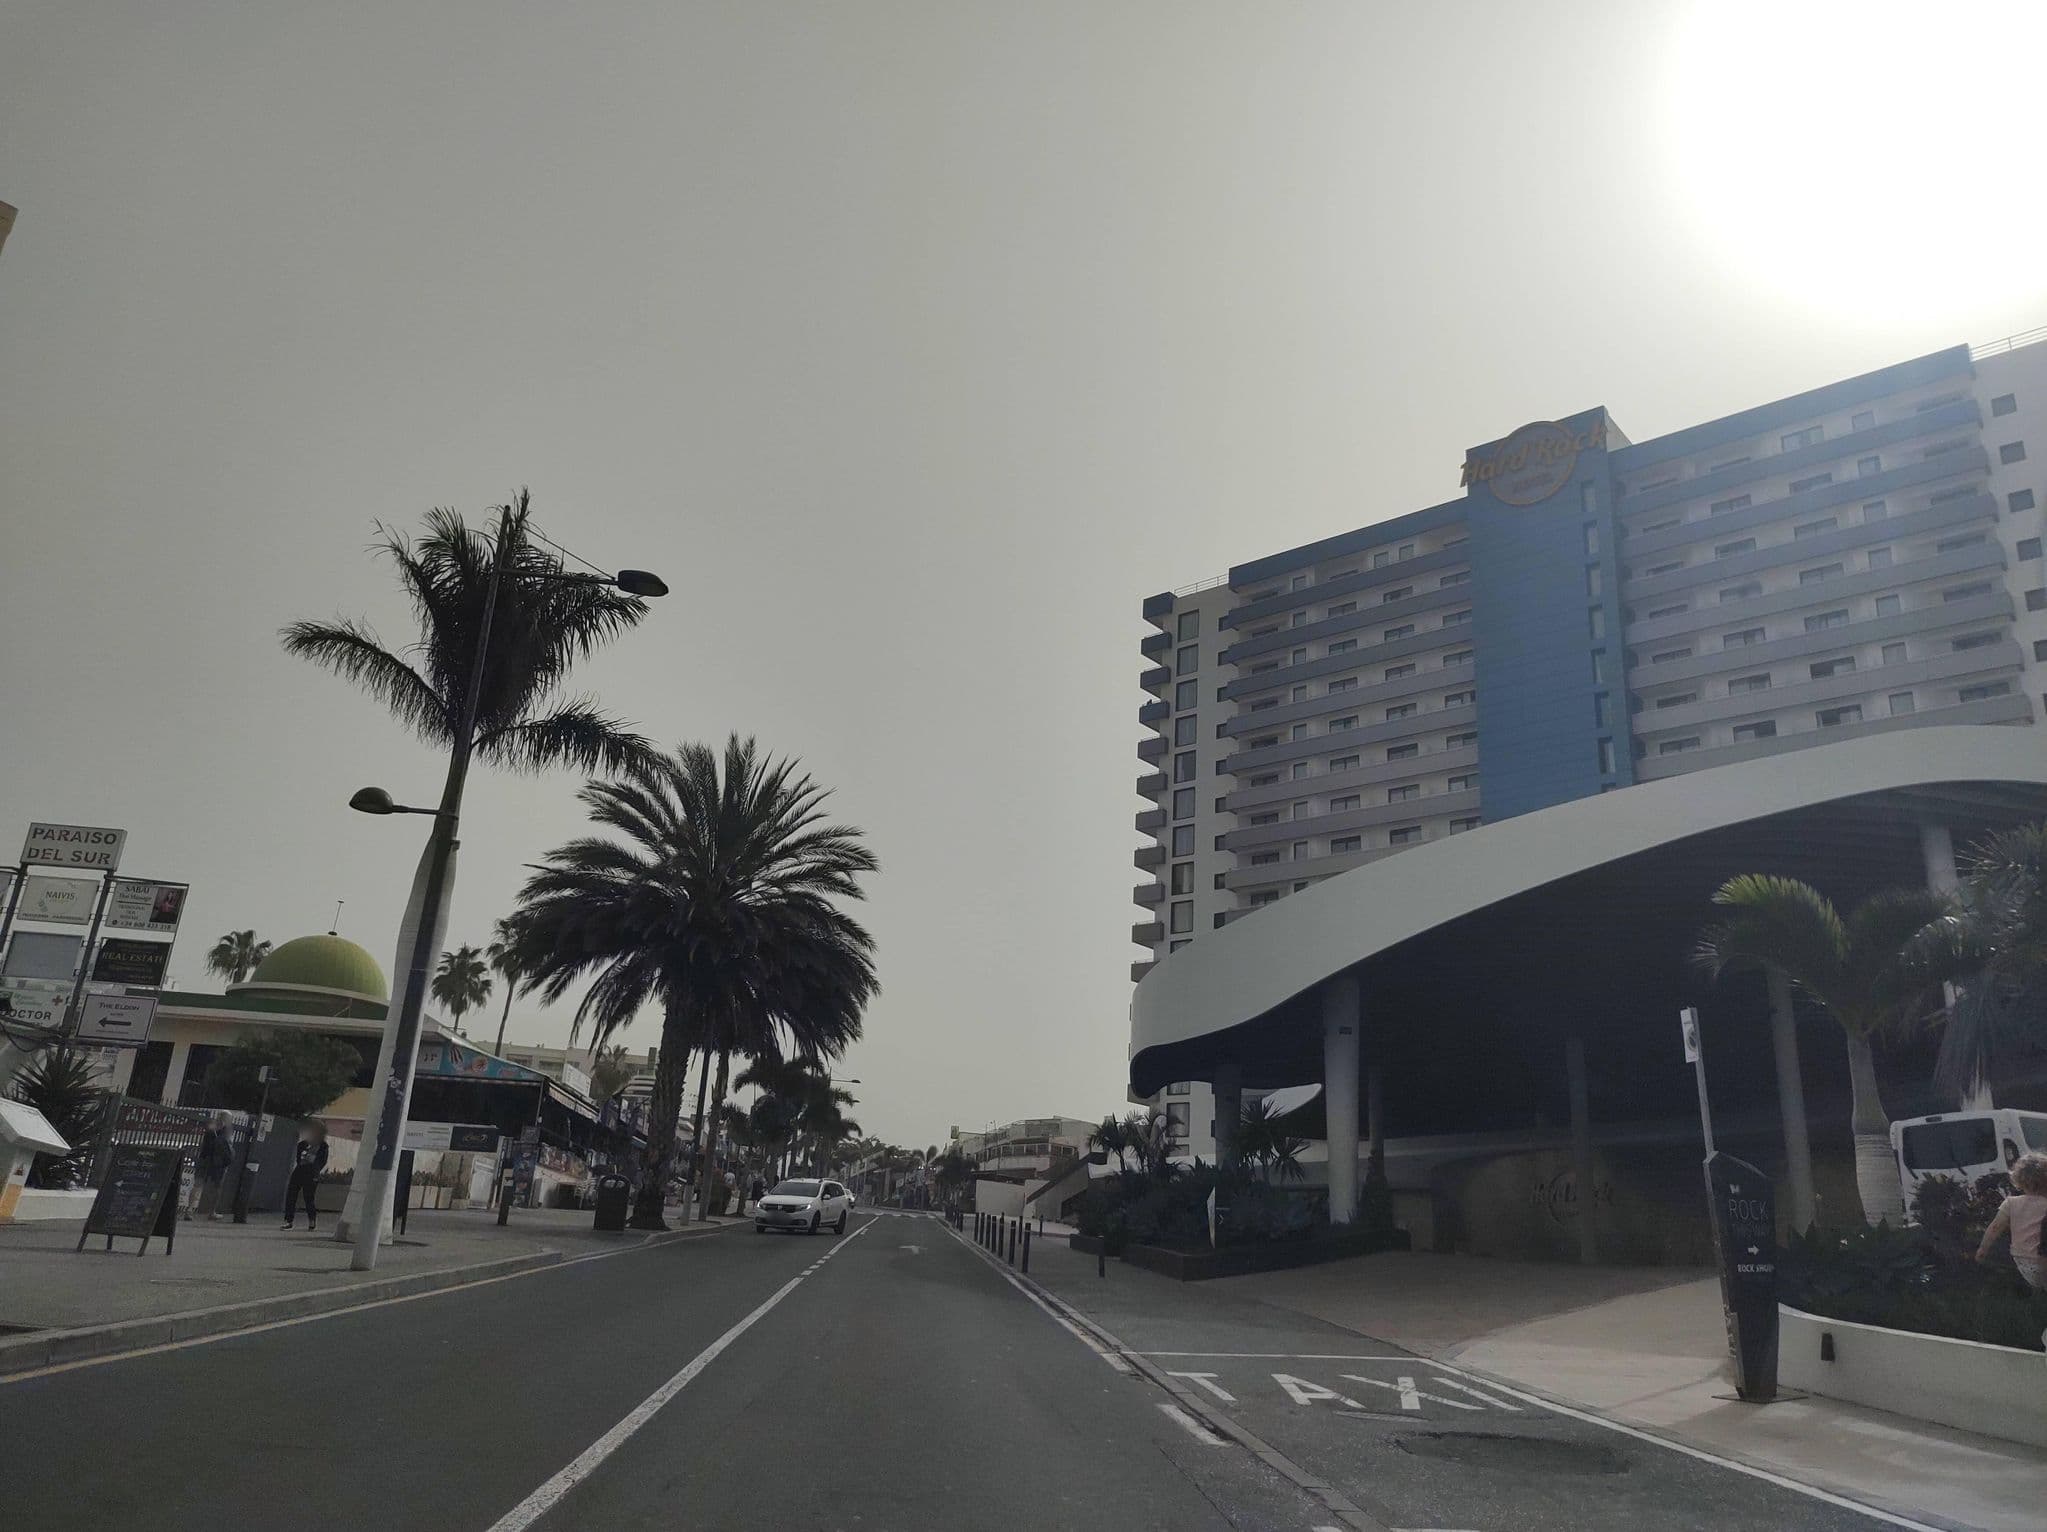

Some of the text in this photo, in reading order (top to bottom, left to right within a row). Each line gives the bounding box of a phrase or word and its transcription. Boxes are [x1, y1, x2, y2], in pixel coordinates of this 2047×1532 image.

[31, 826, 118, 845] PARAISO
[27, 847, 112, 865] DEL SUR
[1728, 1198, 1769, 1222] ROCK
[1737, 1263, 1754, 1273] ROCK
[1165, 1372, 1525, 1411] TAXI
